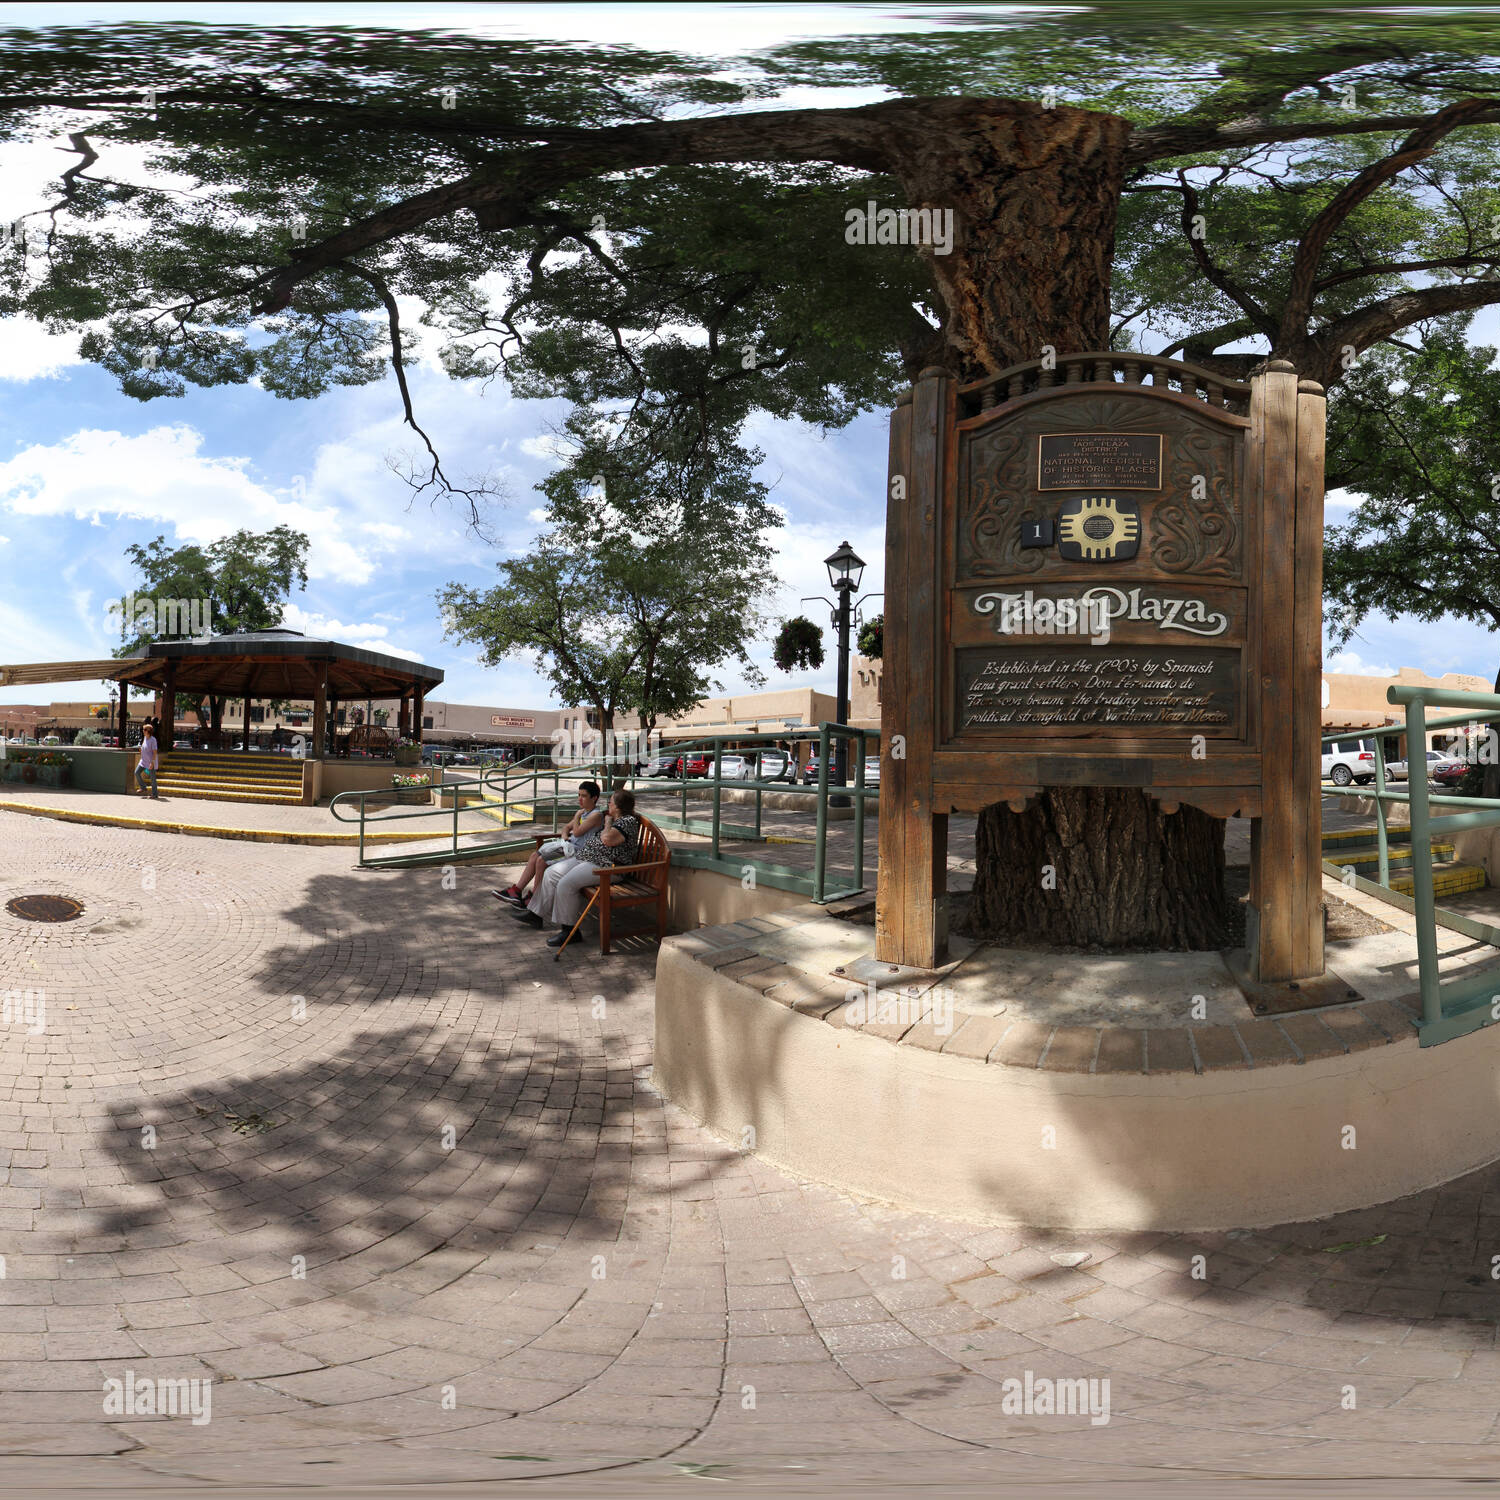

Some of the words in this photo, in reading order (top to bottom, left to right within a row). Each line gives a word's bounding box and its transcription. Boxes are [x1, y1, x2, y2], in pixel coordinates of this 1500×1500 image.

[1044, 457, 1096, 465] NATIONAL
[1103, 457, 1156, 465] REGISTER
[1062, 465, 1107, 473] HISTORIC
[1033, 525, 1041, 538] 1
[974, 592, 1078, 633] Taos
[1082, 587, 1227, 636] Plaza
[982, 660, 1056, 675] Established
[1056, 661, 1070, 673] in
[1071, 659, 1092, 673] the
[1143, 659, 1160, 676] by
[1161, 659, 1214, 676] Spanish
[969, 678, 998, 690] land
[995, 677, 1033, 695] grant
[1085, 675, 1112, 689] Don
[1180, 677, 1195, 689] de
[1072, 692, 1092, 705] the
[1095, 692, 1140, 707] trading
[1184, 692, 1214, 706] and
[965, 709, 1016, 726] political
[1017, 708, 1080, 725] stronghold
[1083, 709, 1099, 722] of
[1100, 708, 1152, 722] Northern
[1155, 708, 1185, 722] New
